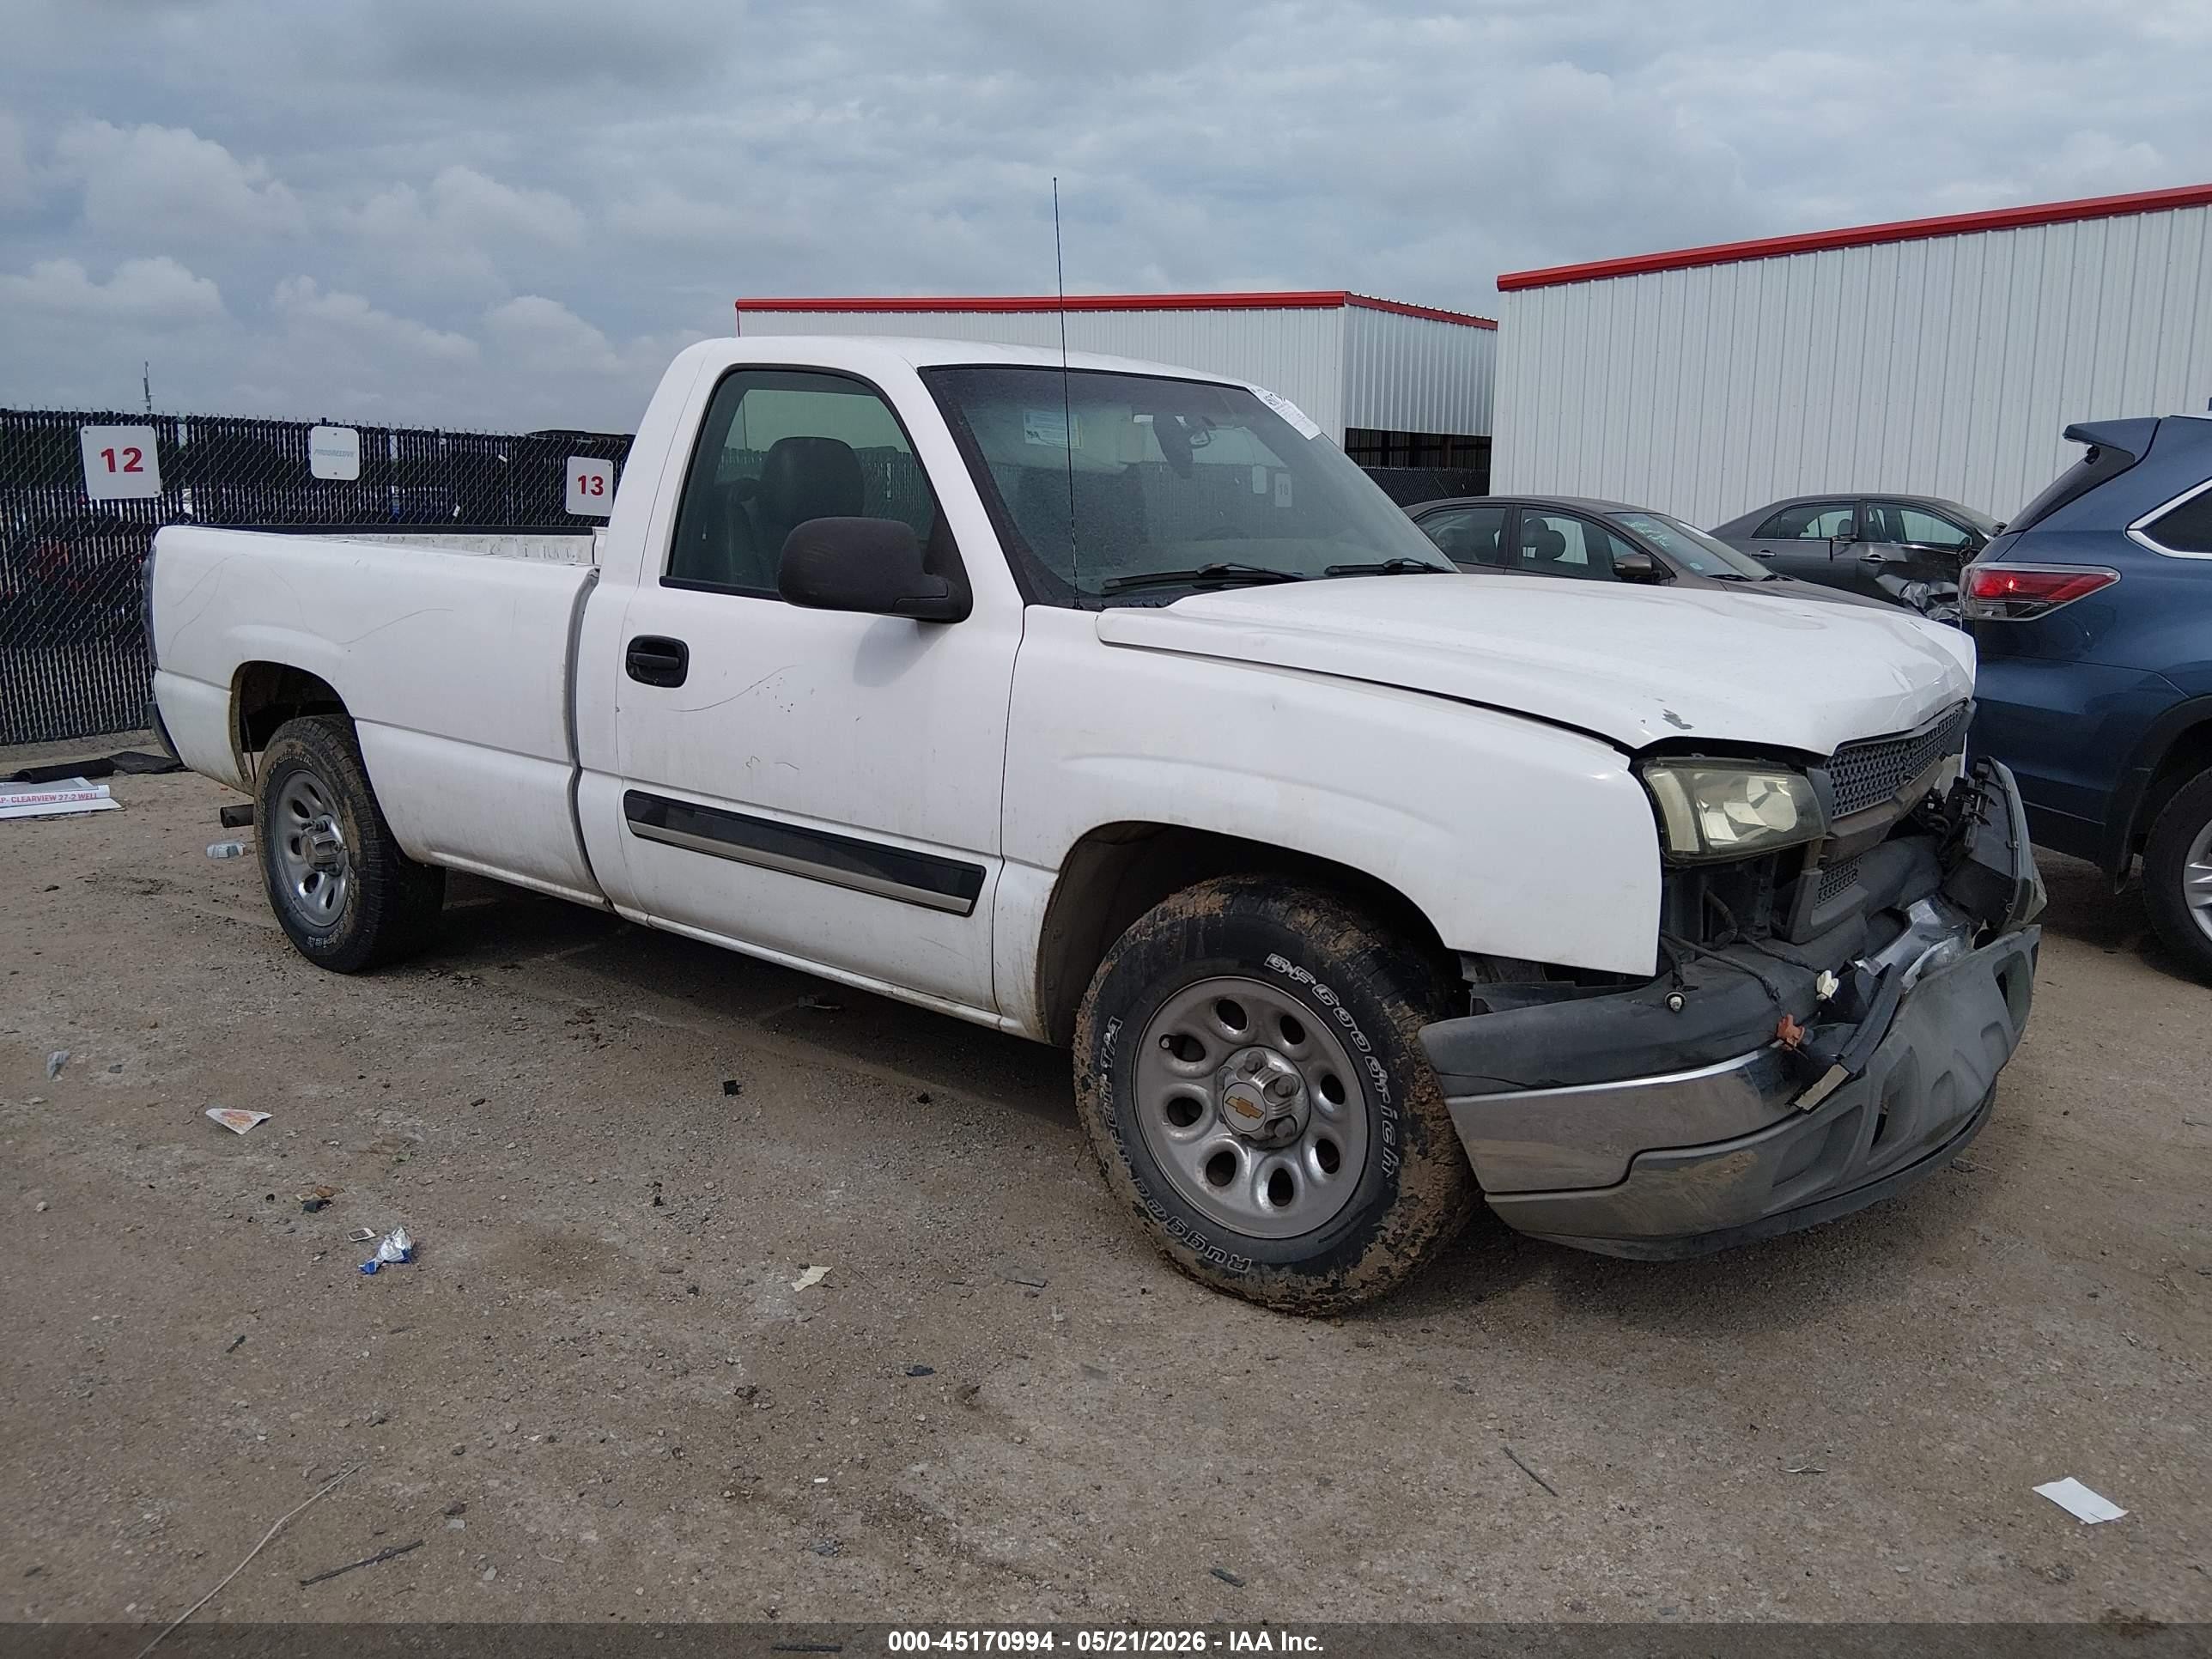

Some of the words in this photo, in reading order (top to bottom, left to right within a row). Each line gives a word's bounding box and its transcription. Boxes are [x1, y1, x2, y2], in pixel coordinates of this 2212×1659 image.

[100, 447, 144, 473] 12
[577, 475, 605, 496] 13
[11, 794, 56, 803] CLEARVIEW
